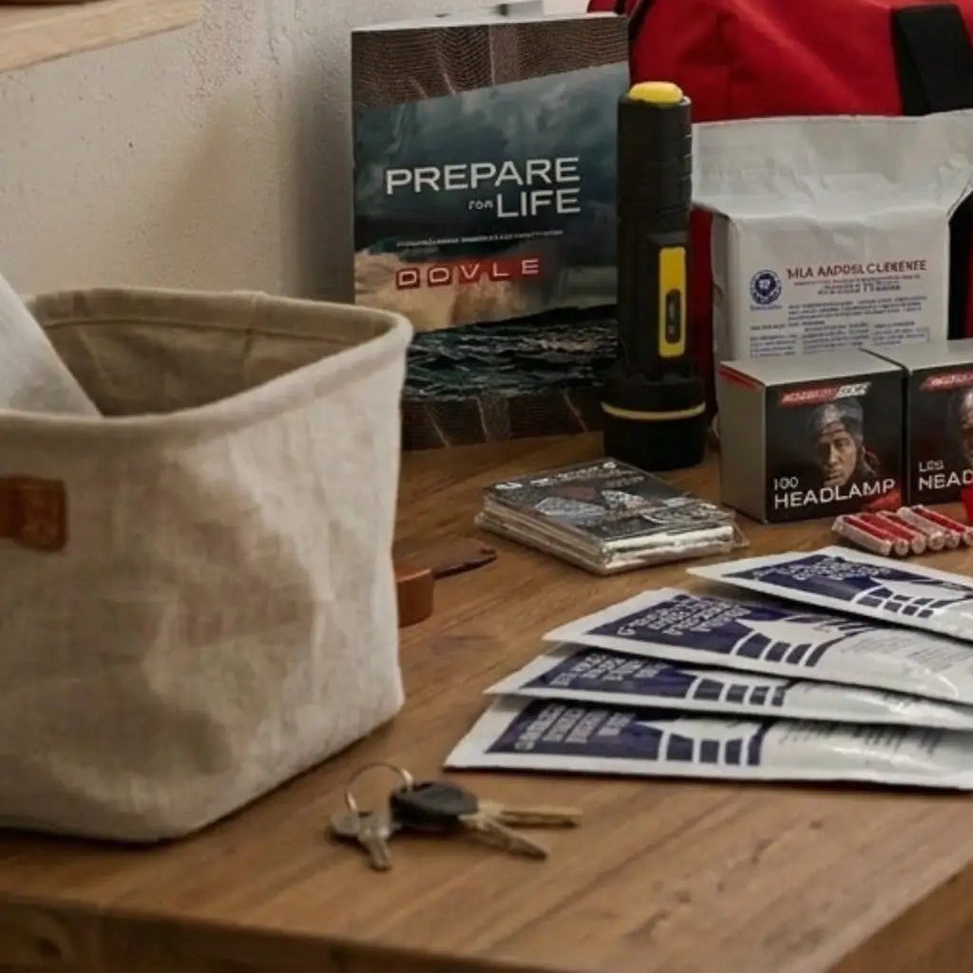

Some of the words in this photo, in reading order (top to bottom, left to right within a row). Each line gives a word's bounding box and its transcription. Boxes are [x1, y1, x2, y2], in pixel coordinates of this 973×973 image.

[386, 157, 580, 195] PREPARE
[497, 188, 581, 218] LIFE
[774, 478, 896, 510] HEADLAMP
